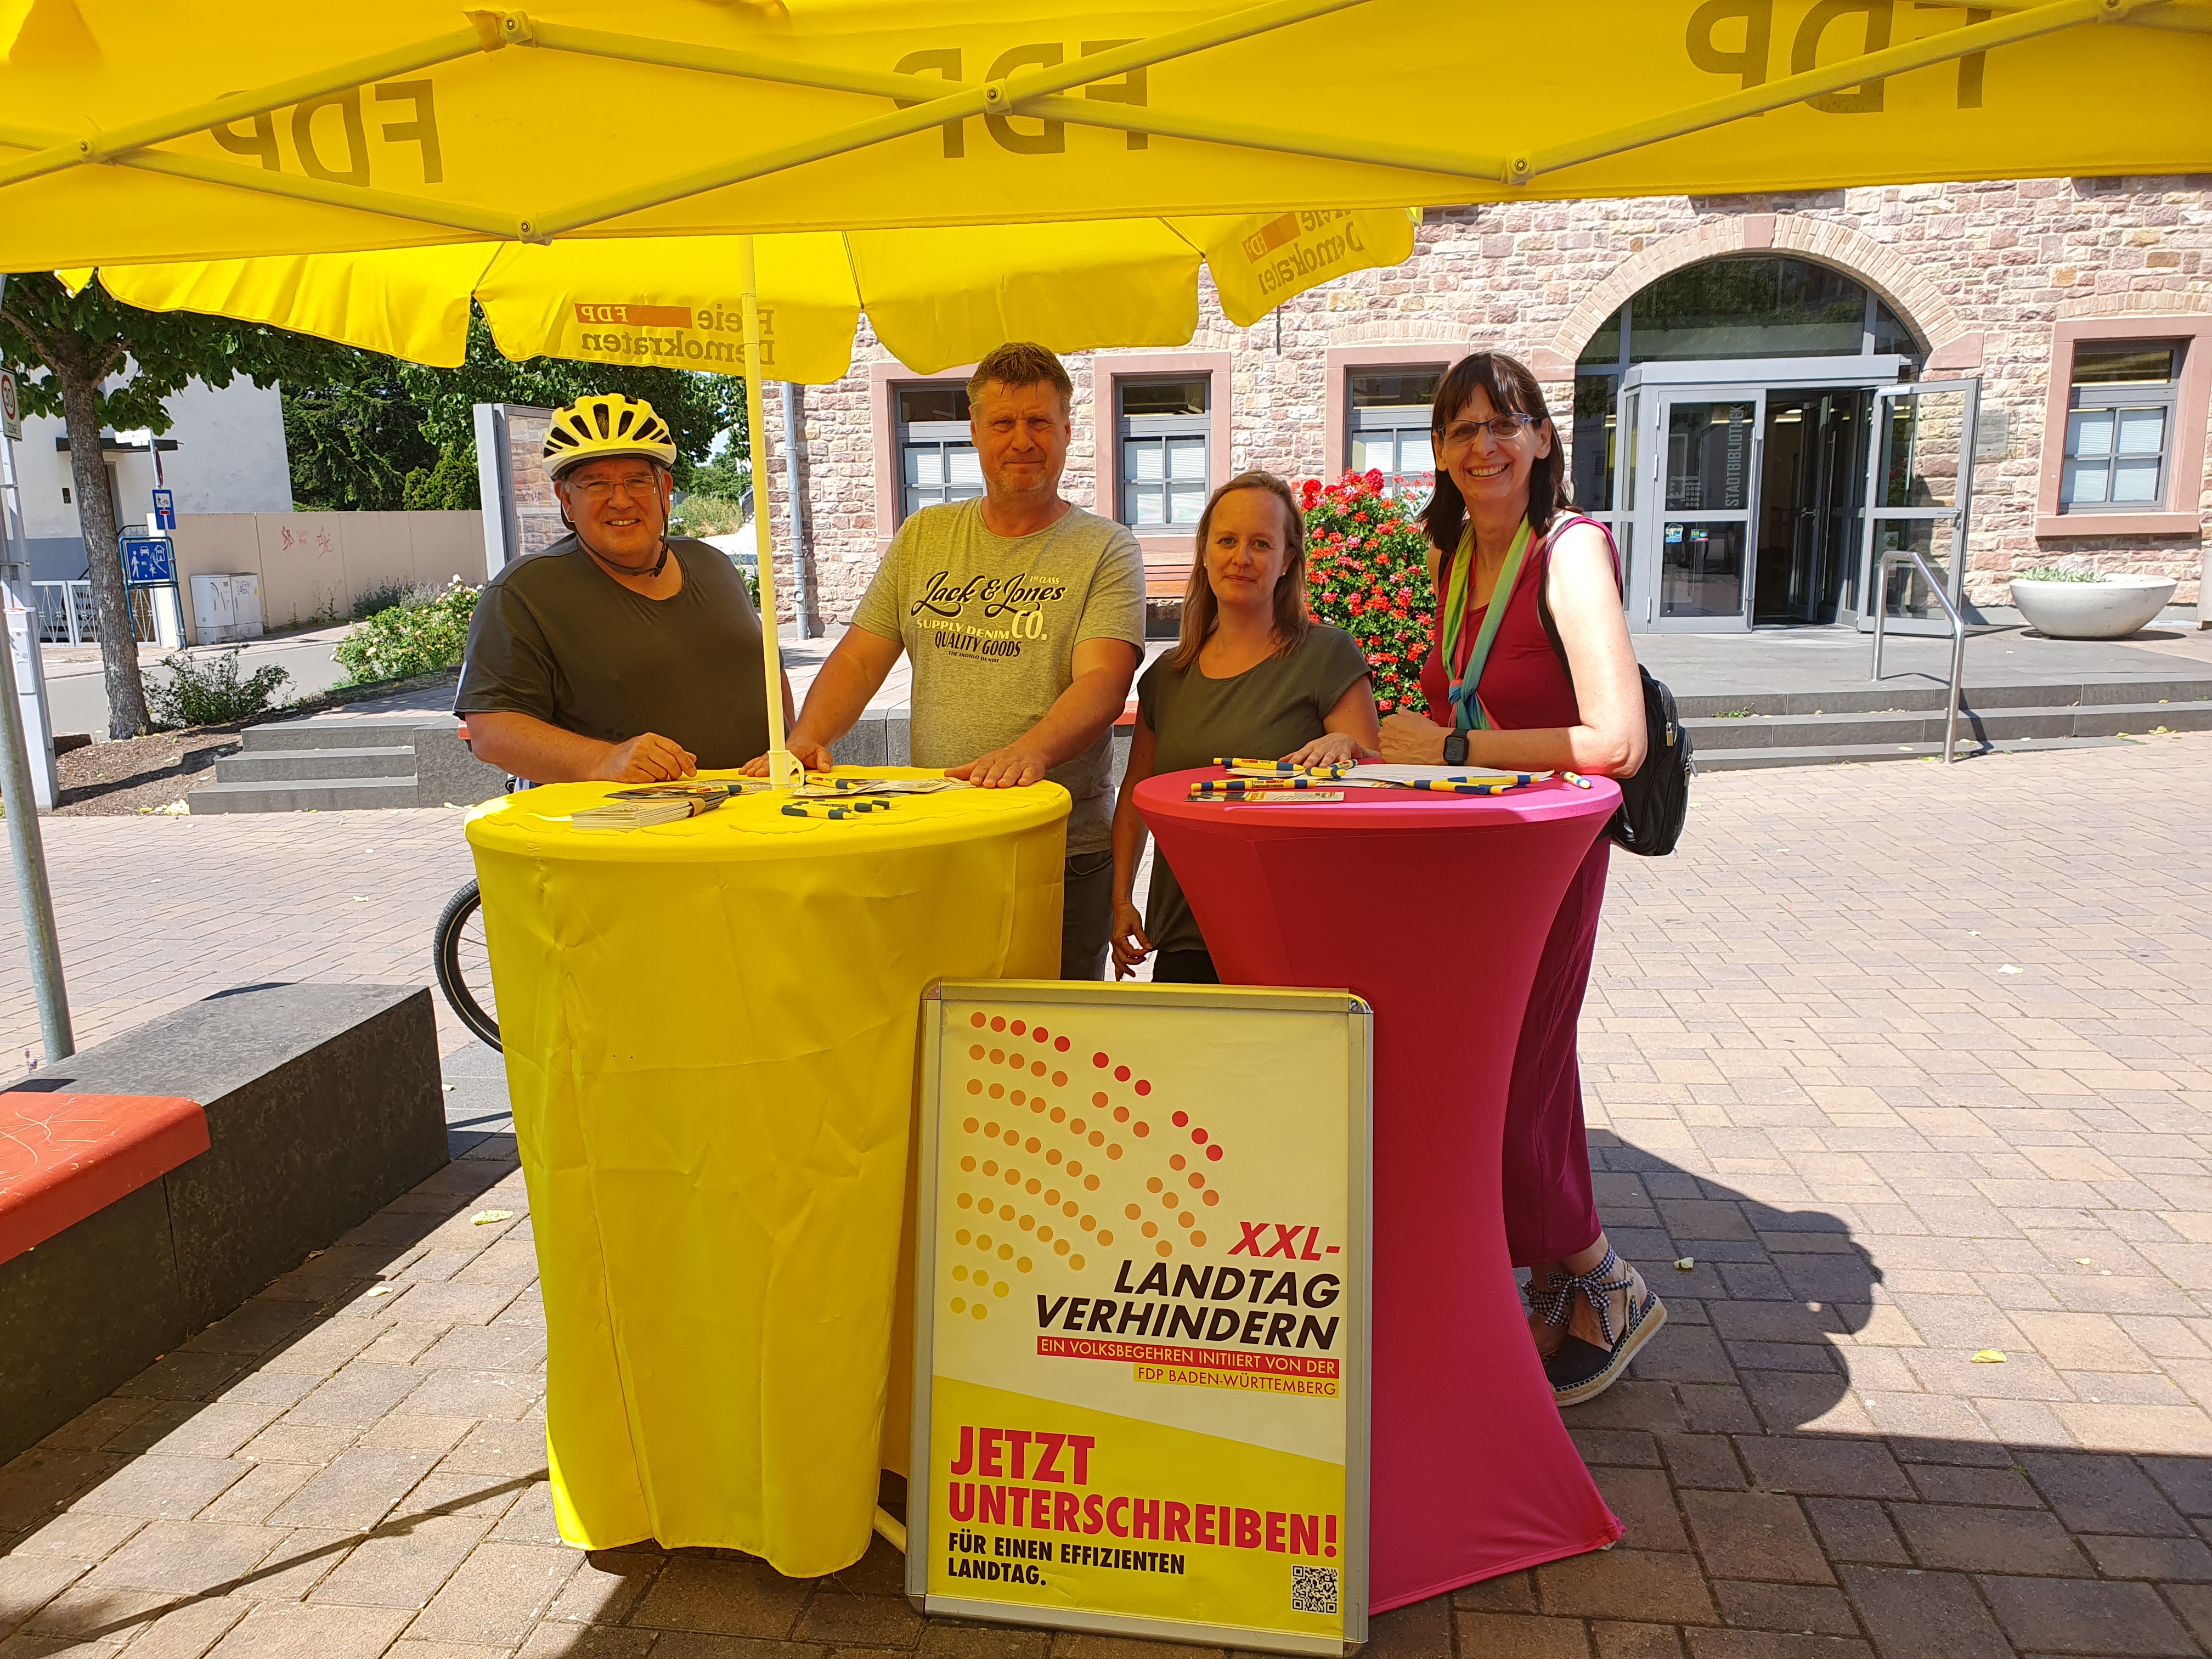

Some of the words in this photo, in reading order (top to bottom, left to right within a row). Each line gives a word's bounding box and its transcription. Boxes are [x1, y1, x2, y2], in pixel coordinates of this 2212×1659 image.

[4, 387, 13, 408] 30
[1725, 405, 1744, 507] STADTBIBLIOTHEK
[911, 571, 988, 619] Jack
[980, 578, 1005, 603] &
[984, 572, 1068, 619] Jones
[1039, 575, 1060, 585] CLASS
[917, 618, 964, 633] SUPPLY
[966, 625, 1009, 640] DENIM
[1011, 610, 1048, 641] CO.
[935, 631, 981, 653] QUALITY
[982, 640, 1022, 657] GOODS
[1227, 1221, 1340, 1262] XXL-
[1114, 1260, 1340, 1309] LANDTAG
[1037, 1294, 1339, 1351] VERHINDERN
[1041, 1339, 1066, 1355] EIN
[1069, 1340, 1194, 1363] VOLKSBEGEHREN
[1199, 1349, 1261, 1369] INITIIERT
[1265, 1355, 1302, 1372] VON
[1307, 1357, 1336, 1375] DER
[1138, 1367, 1164, 1381] FDP
[1168, 1368, 1337, 1396] BADEN-WÜRTTEMBERG
[951, 1426, 1096, 1486] JETZT
[949, 1482, 1337, 1558] UNTERSCHREIBEN!
[948, 1558, 1047, 1587] LANDTAG.
[949, 1528, 986, 1555] FÜR
[995, 1536, 1052, 1562] EINEN
[1060, 1542, 1185, 1576] EFFIZIENTEN
